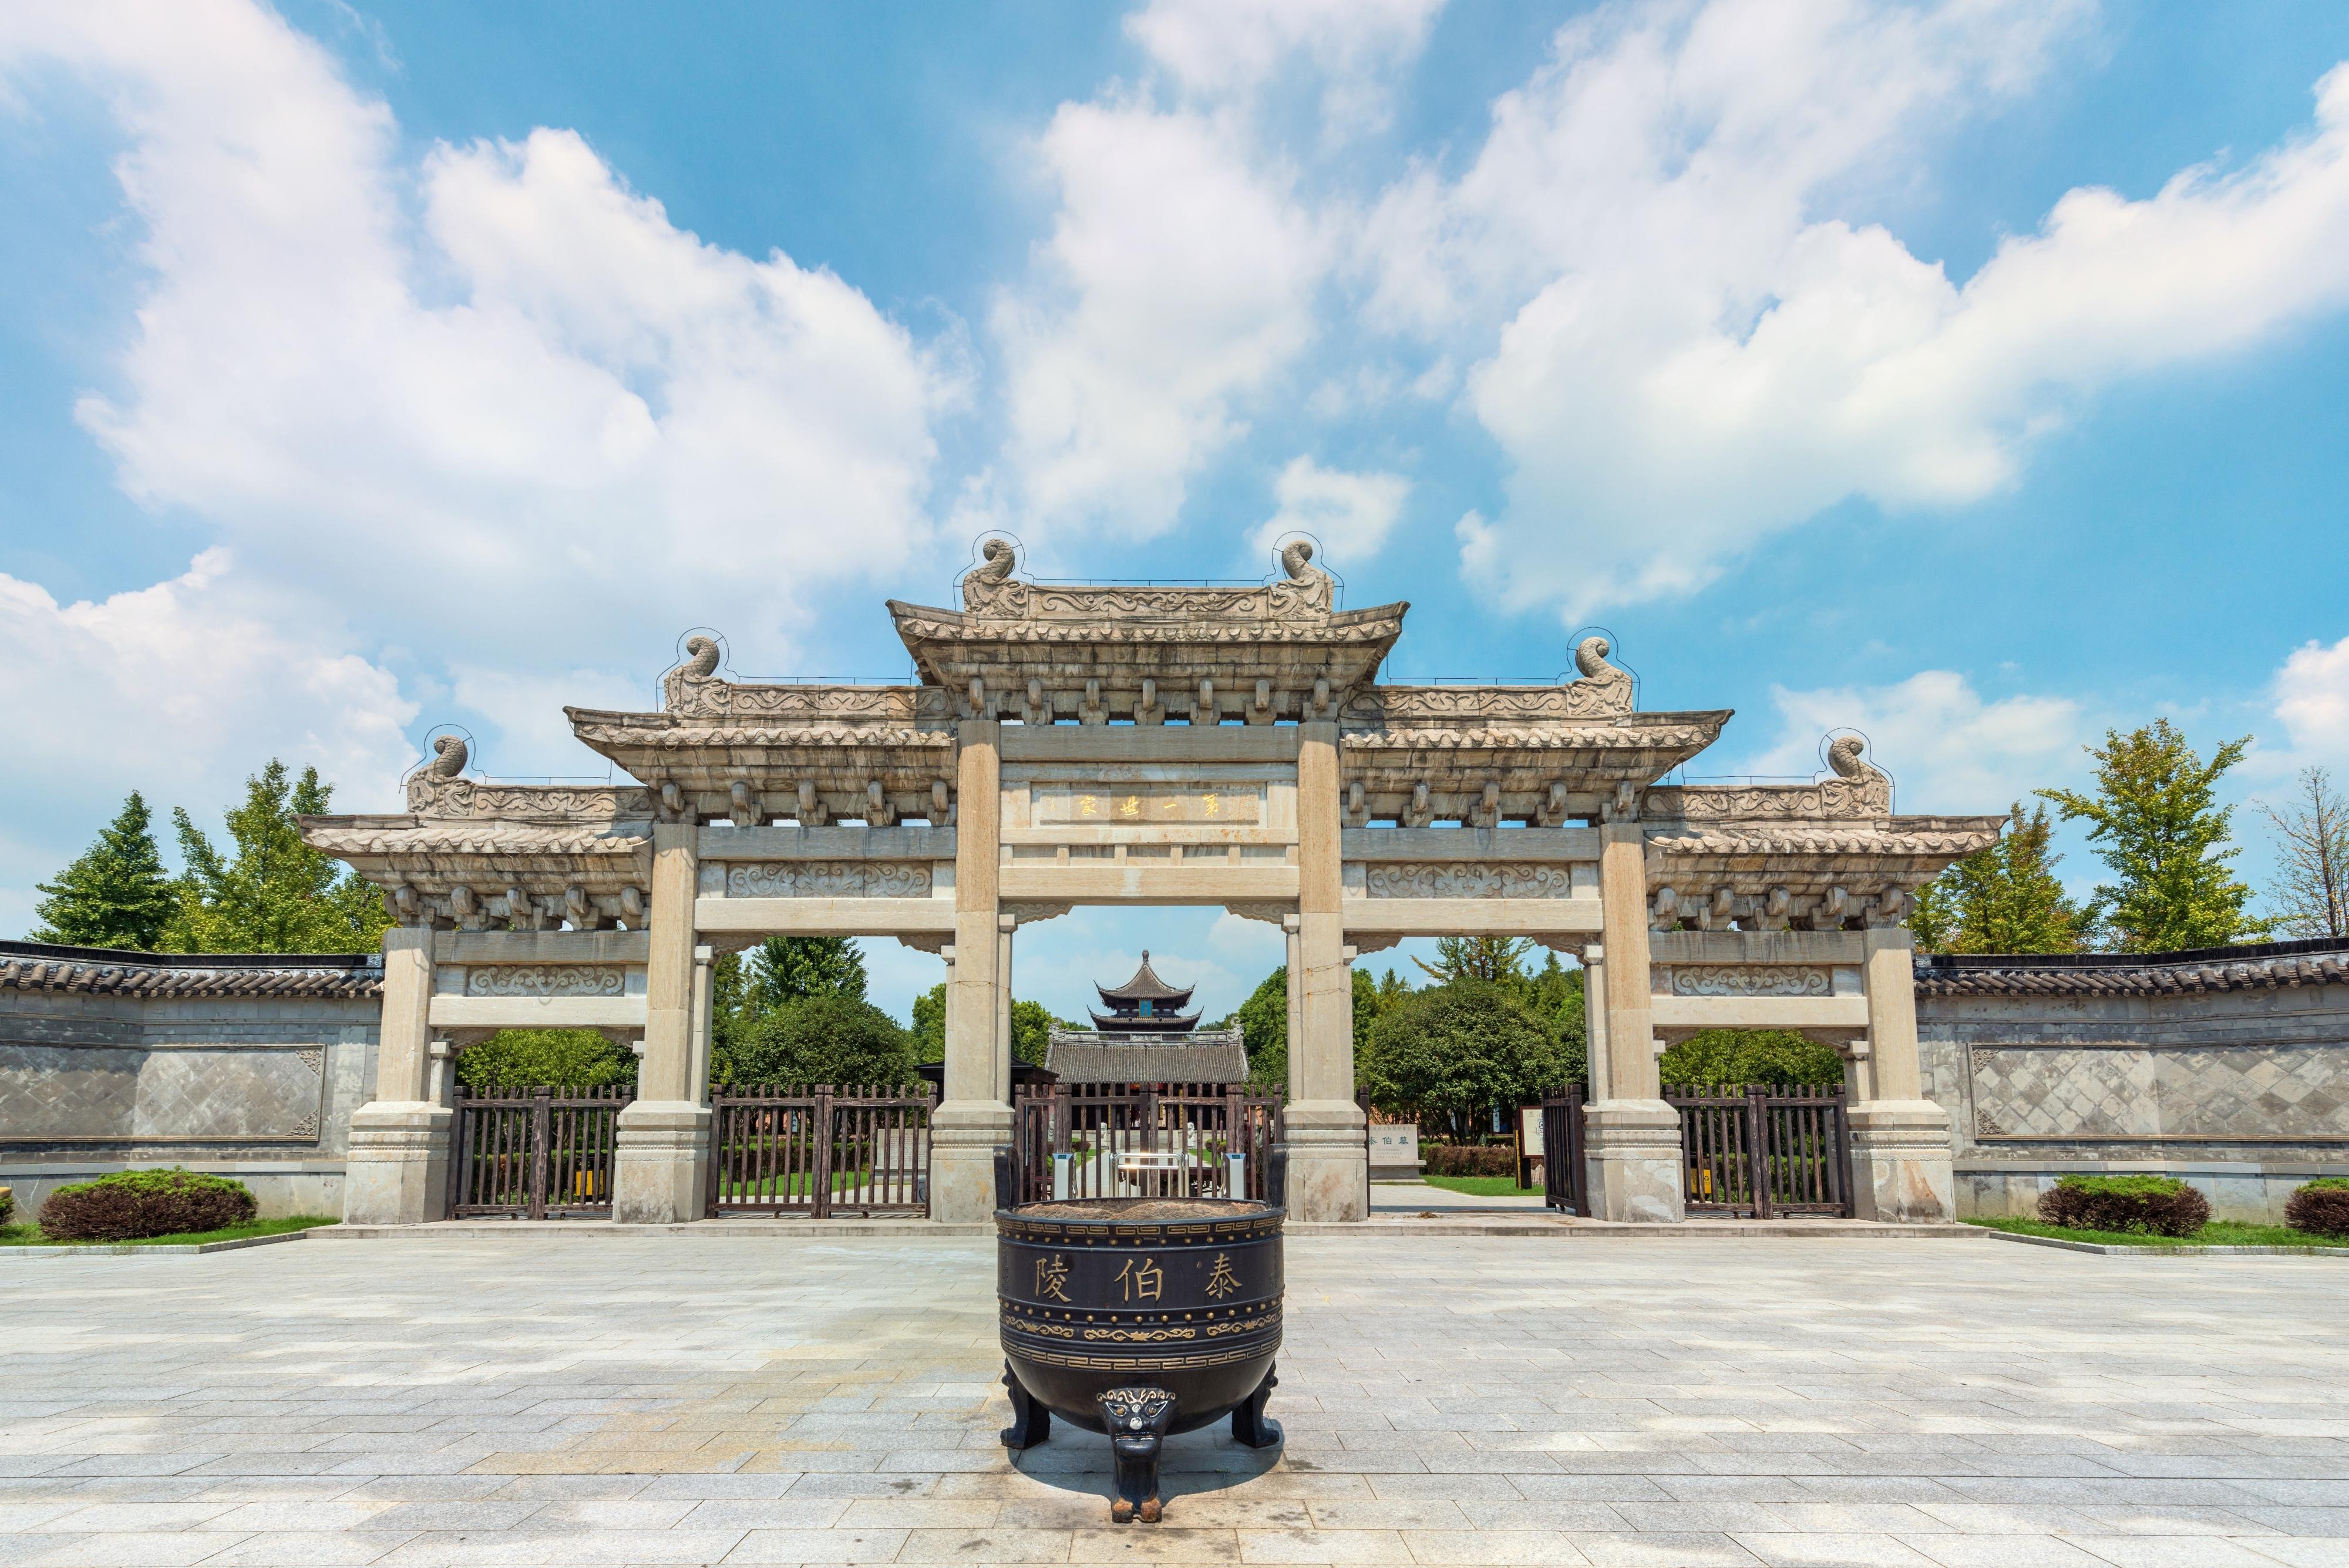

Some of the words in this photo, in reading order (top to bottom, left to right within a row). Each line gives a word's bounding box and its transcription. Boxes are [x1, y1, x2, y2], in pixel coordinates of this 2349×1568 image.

[1369, 1136, 1409, 1145] 泰伯墓
[1035, 1253, 1242, 1302] 泰伯陵
